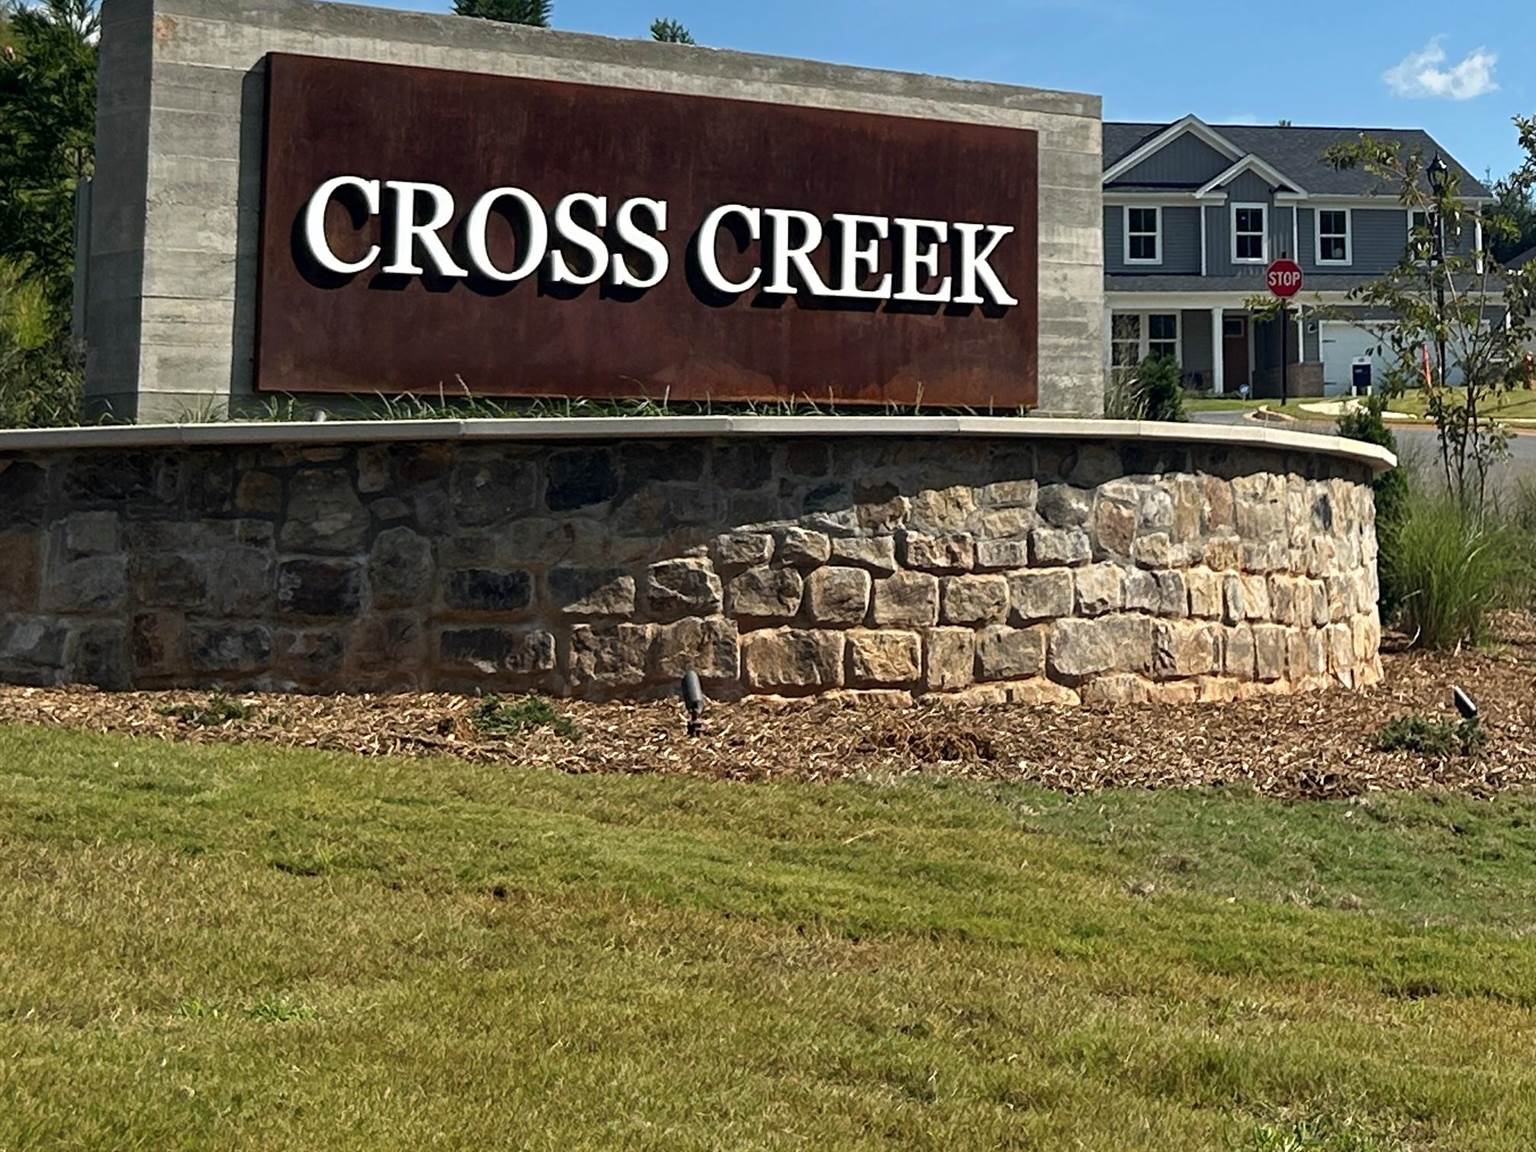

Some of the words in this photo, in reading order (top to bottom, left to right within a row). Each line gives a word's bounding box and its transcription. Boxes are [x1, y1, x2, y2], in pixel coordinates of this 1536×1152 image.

[304, 174, 669, 288] CROSS
[697, 203, 1019, 306] CREEK
[1268, 271, 1301, 286] STOP
